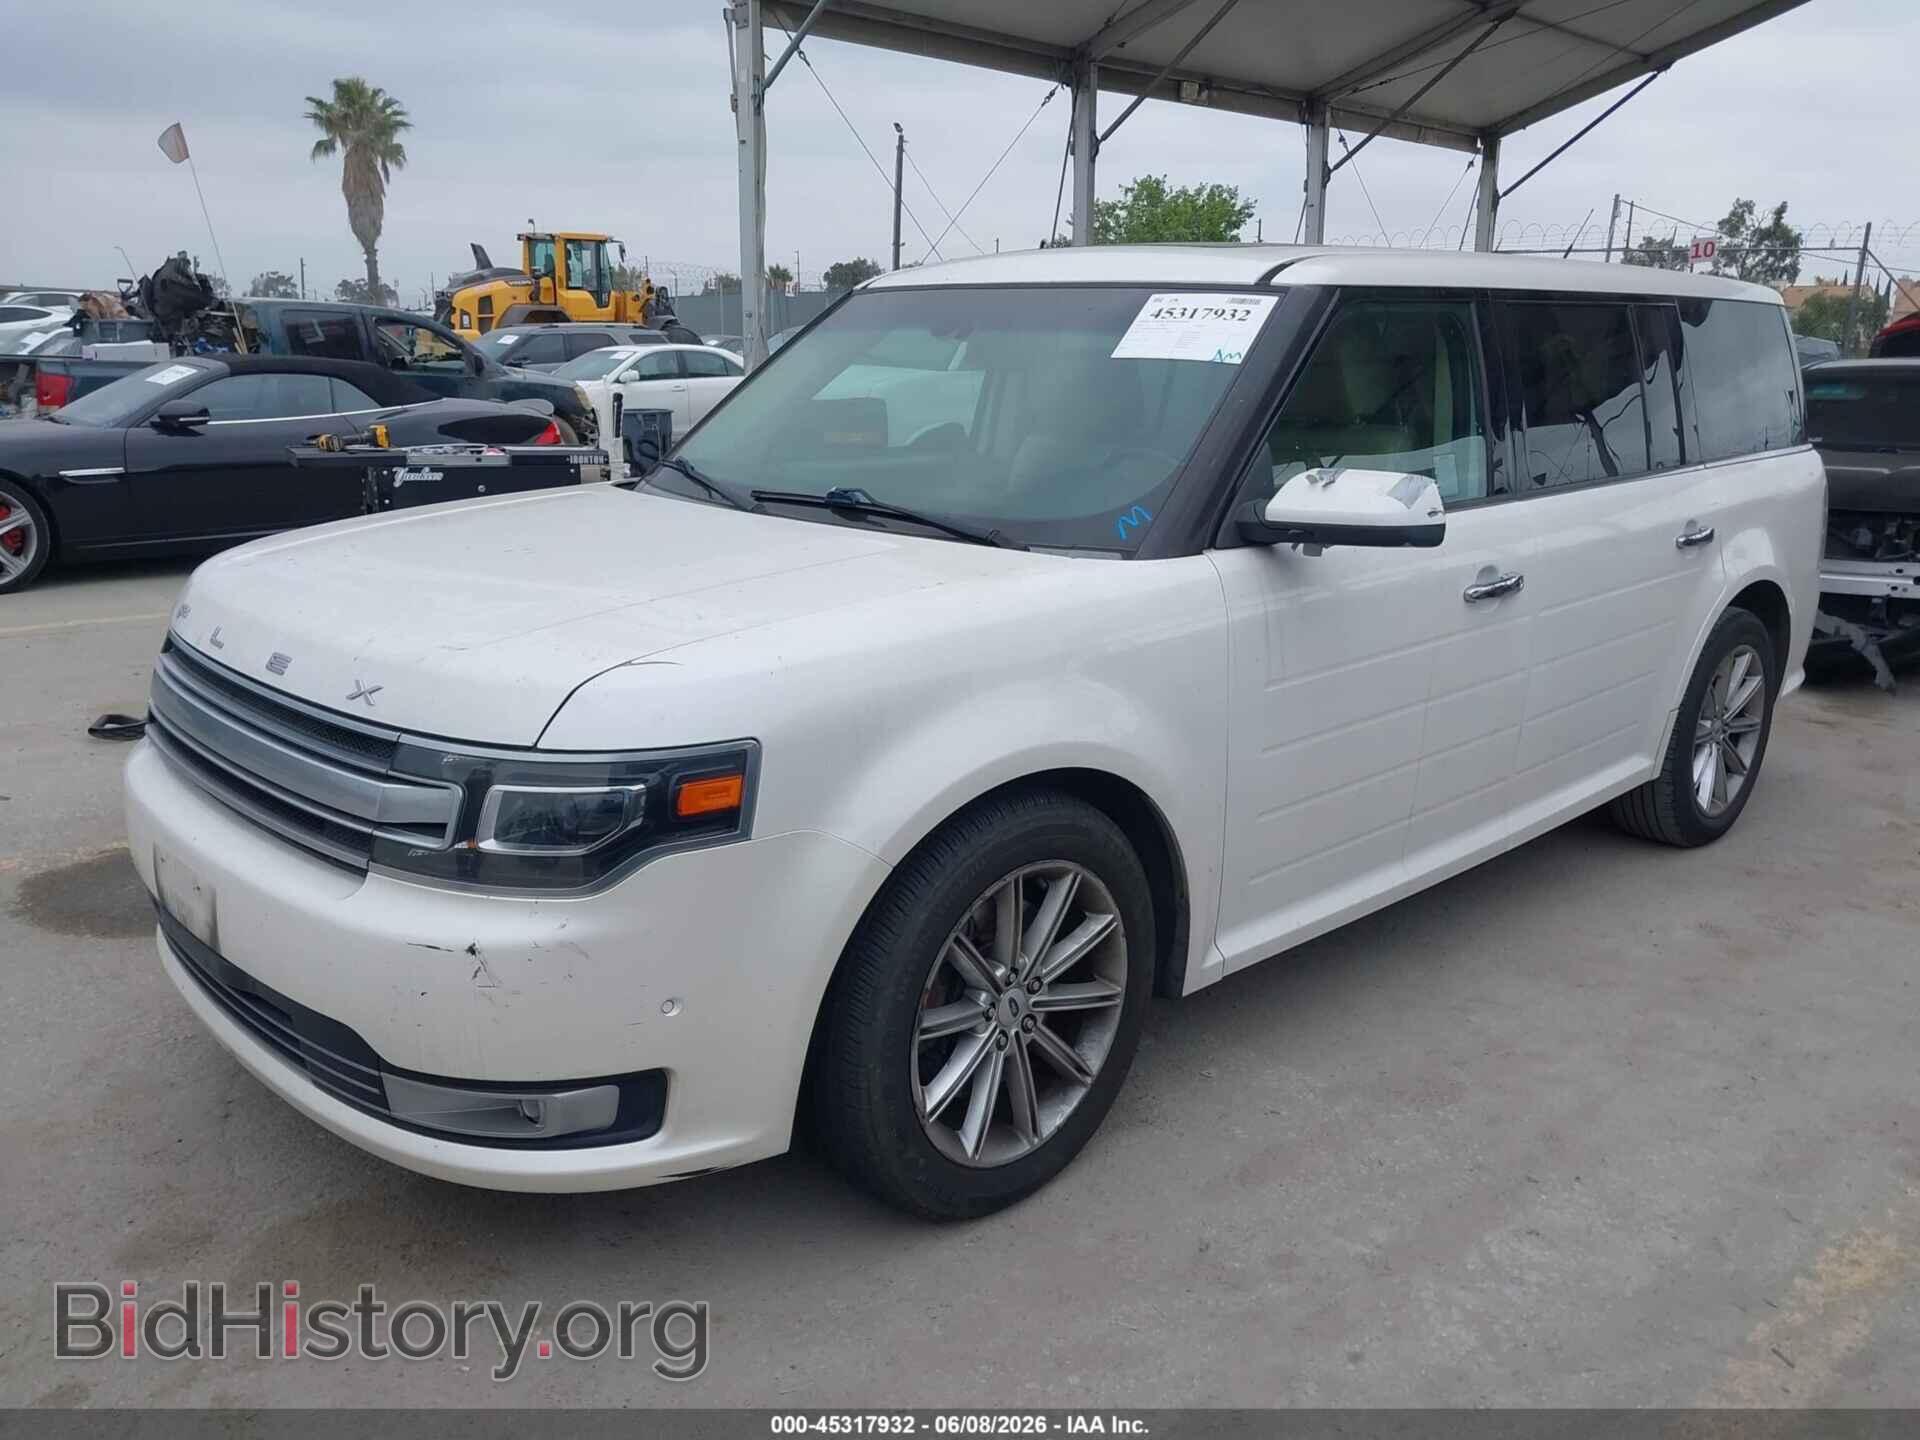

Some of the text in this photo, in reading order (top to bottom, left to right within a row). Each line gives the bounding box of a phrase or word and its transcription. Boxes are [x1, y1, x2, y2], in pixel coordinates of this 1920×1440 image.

[1691, 241, 1715, 259] 10
[1150, 307, 1251, 322] 45317932
[392, 466, 444, 488] Yankees
